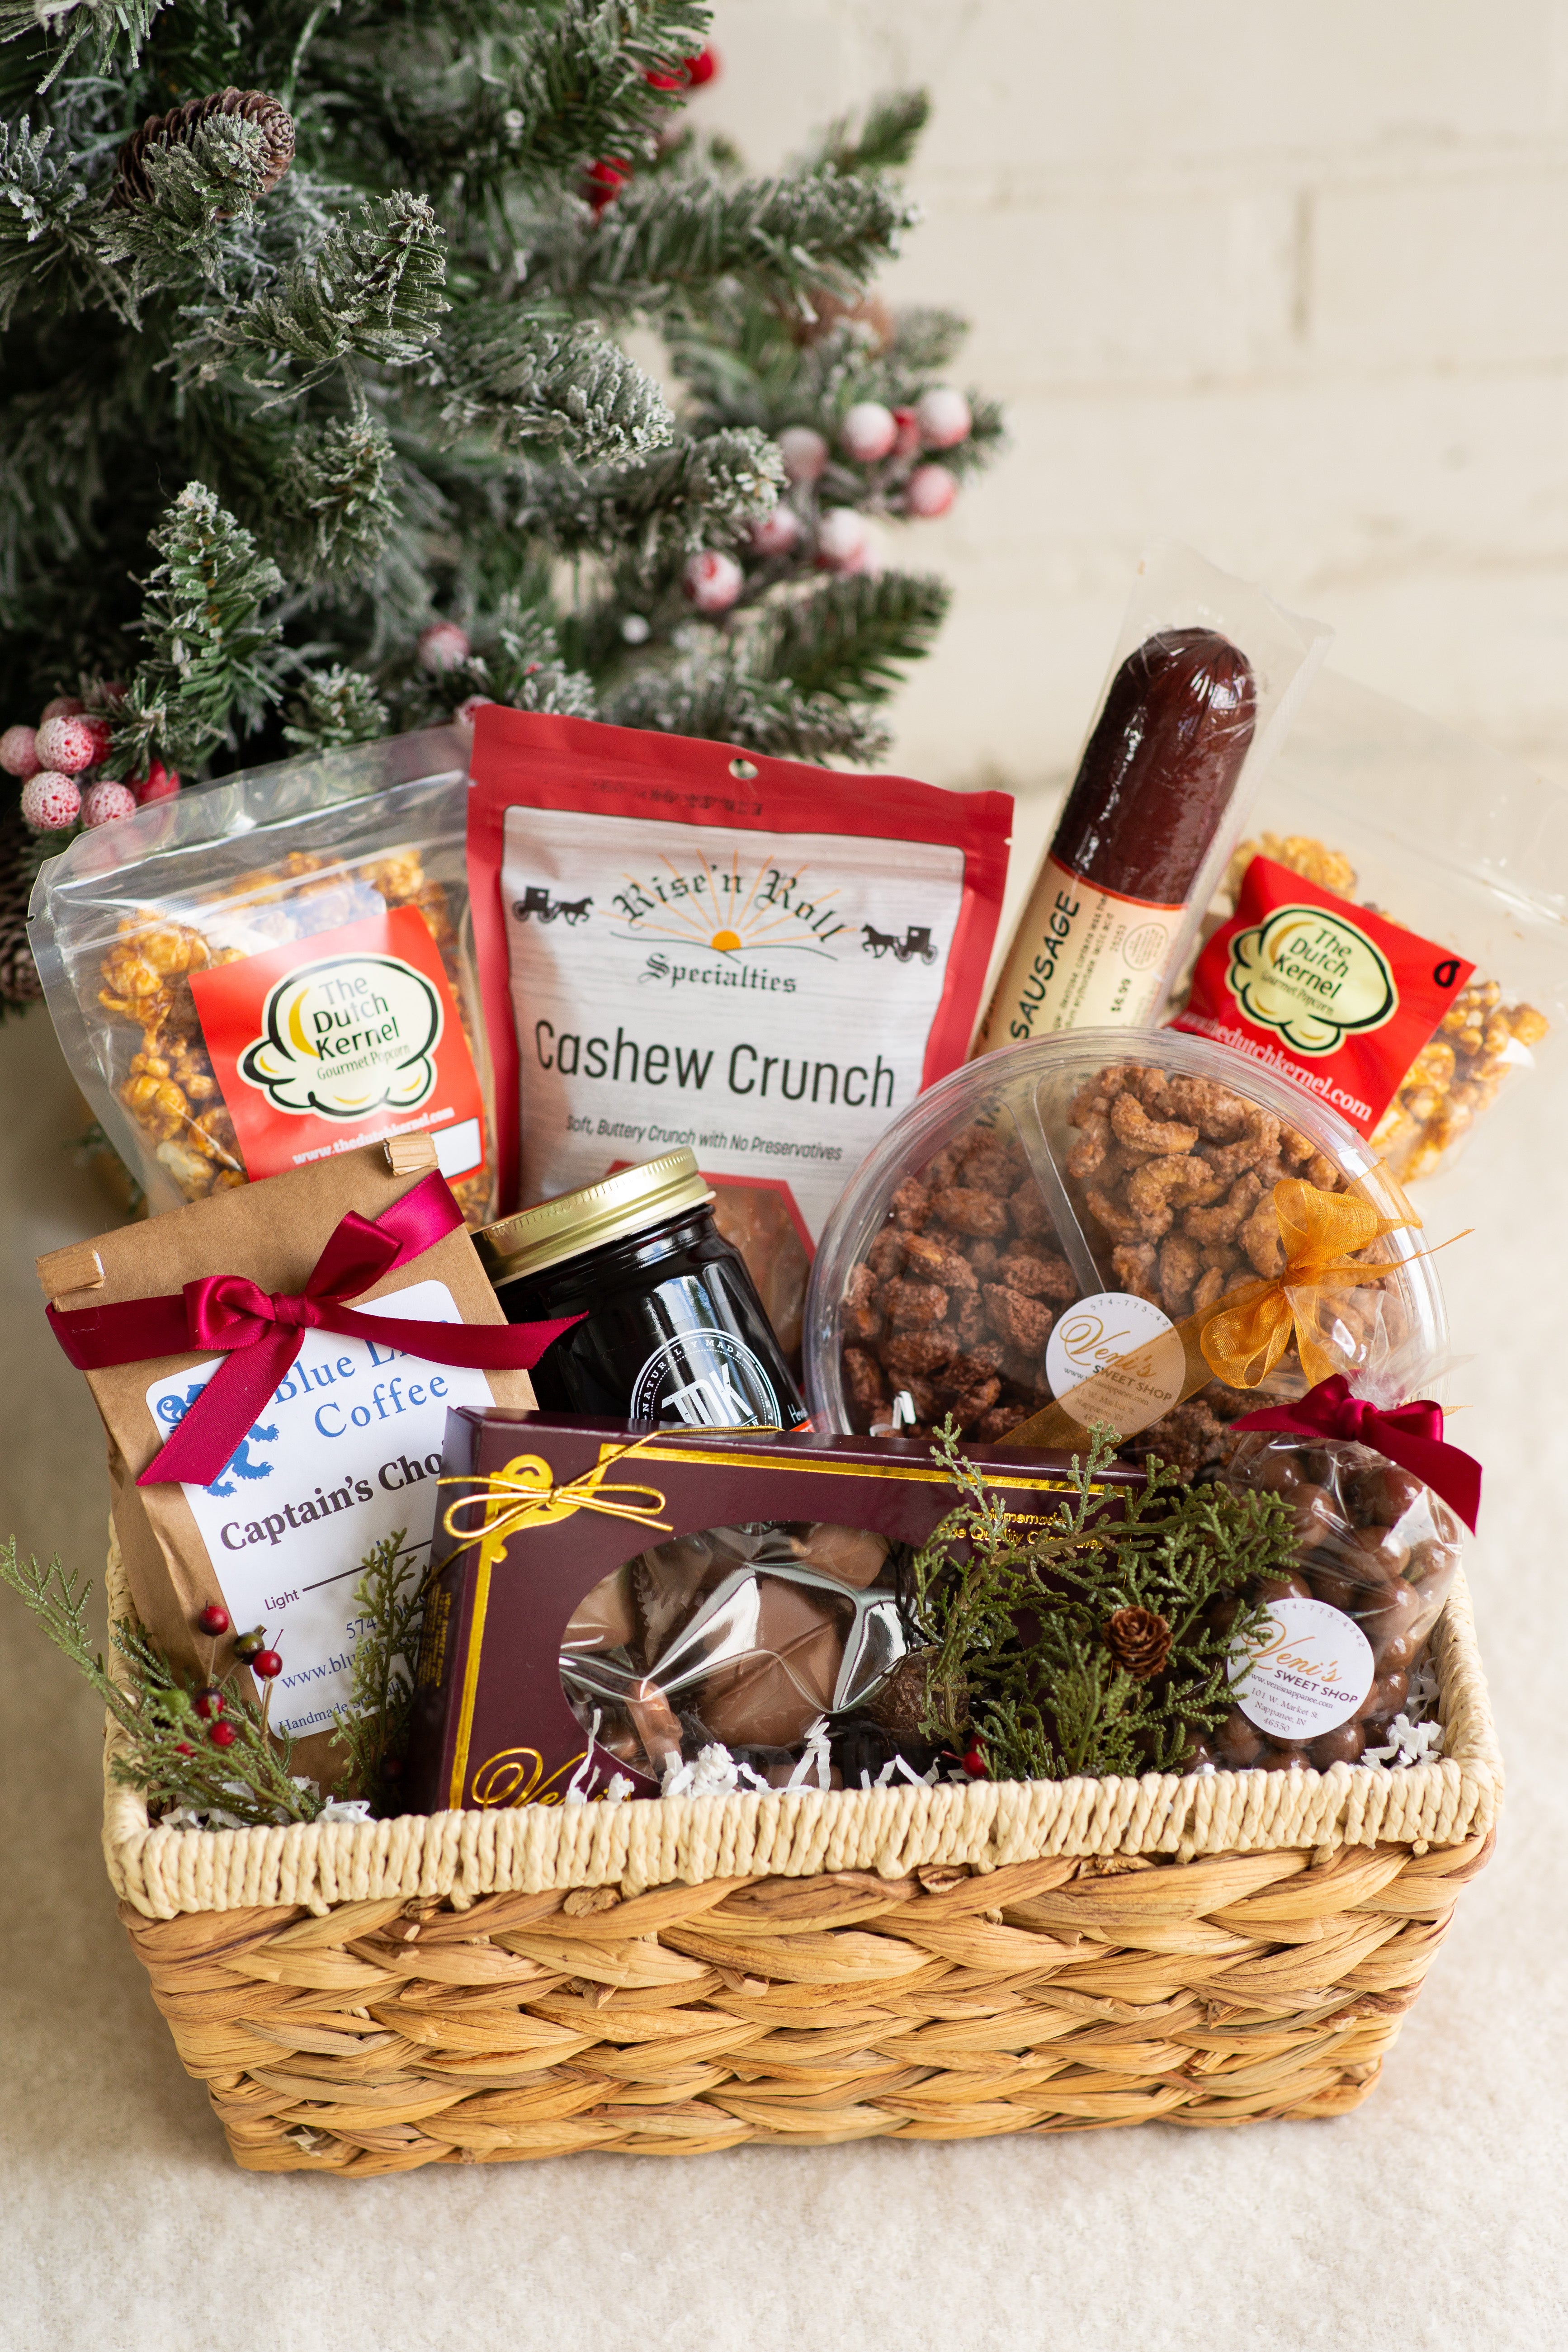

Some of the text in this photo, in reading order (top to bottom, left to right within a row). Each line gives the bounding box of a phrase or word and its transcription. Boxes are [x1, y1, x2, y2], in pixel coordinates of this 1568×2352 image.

[754, 869, 847, 943] Roll
[1289, 937, 1349, 978] Dutch
[1315, 927, 1352, 958] The
[638, 952, 797, 993] Specialties
[1010, 890, 1080, 1039] SAUSAGE
[1272, 954, 1342, 999] Kernel
[320, 976, 369, 1005] The
[1296, 988, 1334, 1016] Popcorn
[312, 993, 389, 1034] Dutch
[315, 1016, 400, 1061] Kernel
[316, 1043, 411, 1080] Gourmet Popcorn
[534, 1018, 714, 1090] Cashew
[727, 1042, 897, 1109] Crunch
[566, 1115, 843, 1161] Soft, Buttery Crunch with No Preservatives
[1059, 1314, 1157, 1378] Veni's
[642, 1339, 743, 1413] NATURALLY MADE
[1092, 1365, 1173, 1401] SWEET SHOP
[314, 1377, 449, 1438] Coffee
[220, 1452, 443, 1550] Captain's Cho
[264, 1590, 300, 1611] Light
[1273, 1604, 1365, 1648] 574-773-4242
[1241, 1620, 1342, 1682] Veni's
[1252, 1687, 1266, 1700] 101
[1269, 1695, 1279, 1705] W.
[1280, 1700, 1309, 1716] Market
[1274, 1670, 1359, 1703] SWEET SHOP
[1255, 1701, 1307, 1726] Nappanee, IN
[1263, 1718, 1290, 1732] 46550
